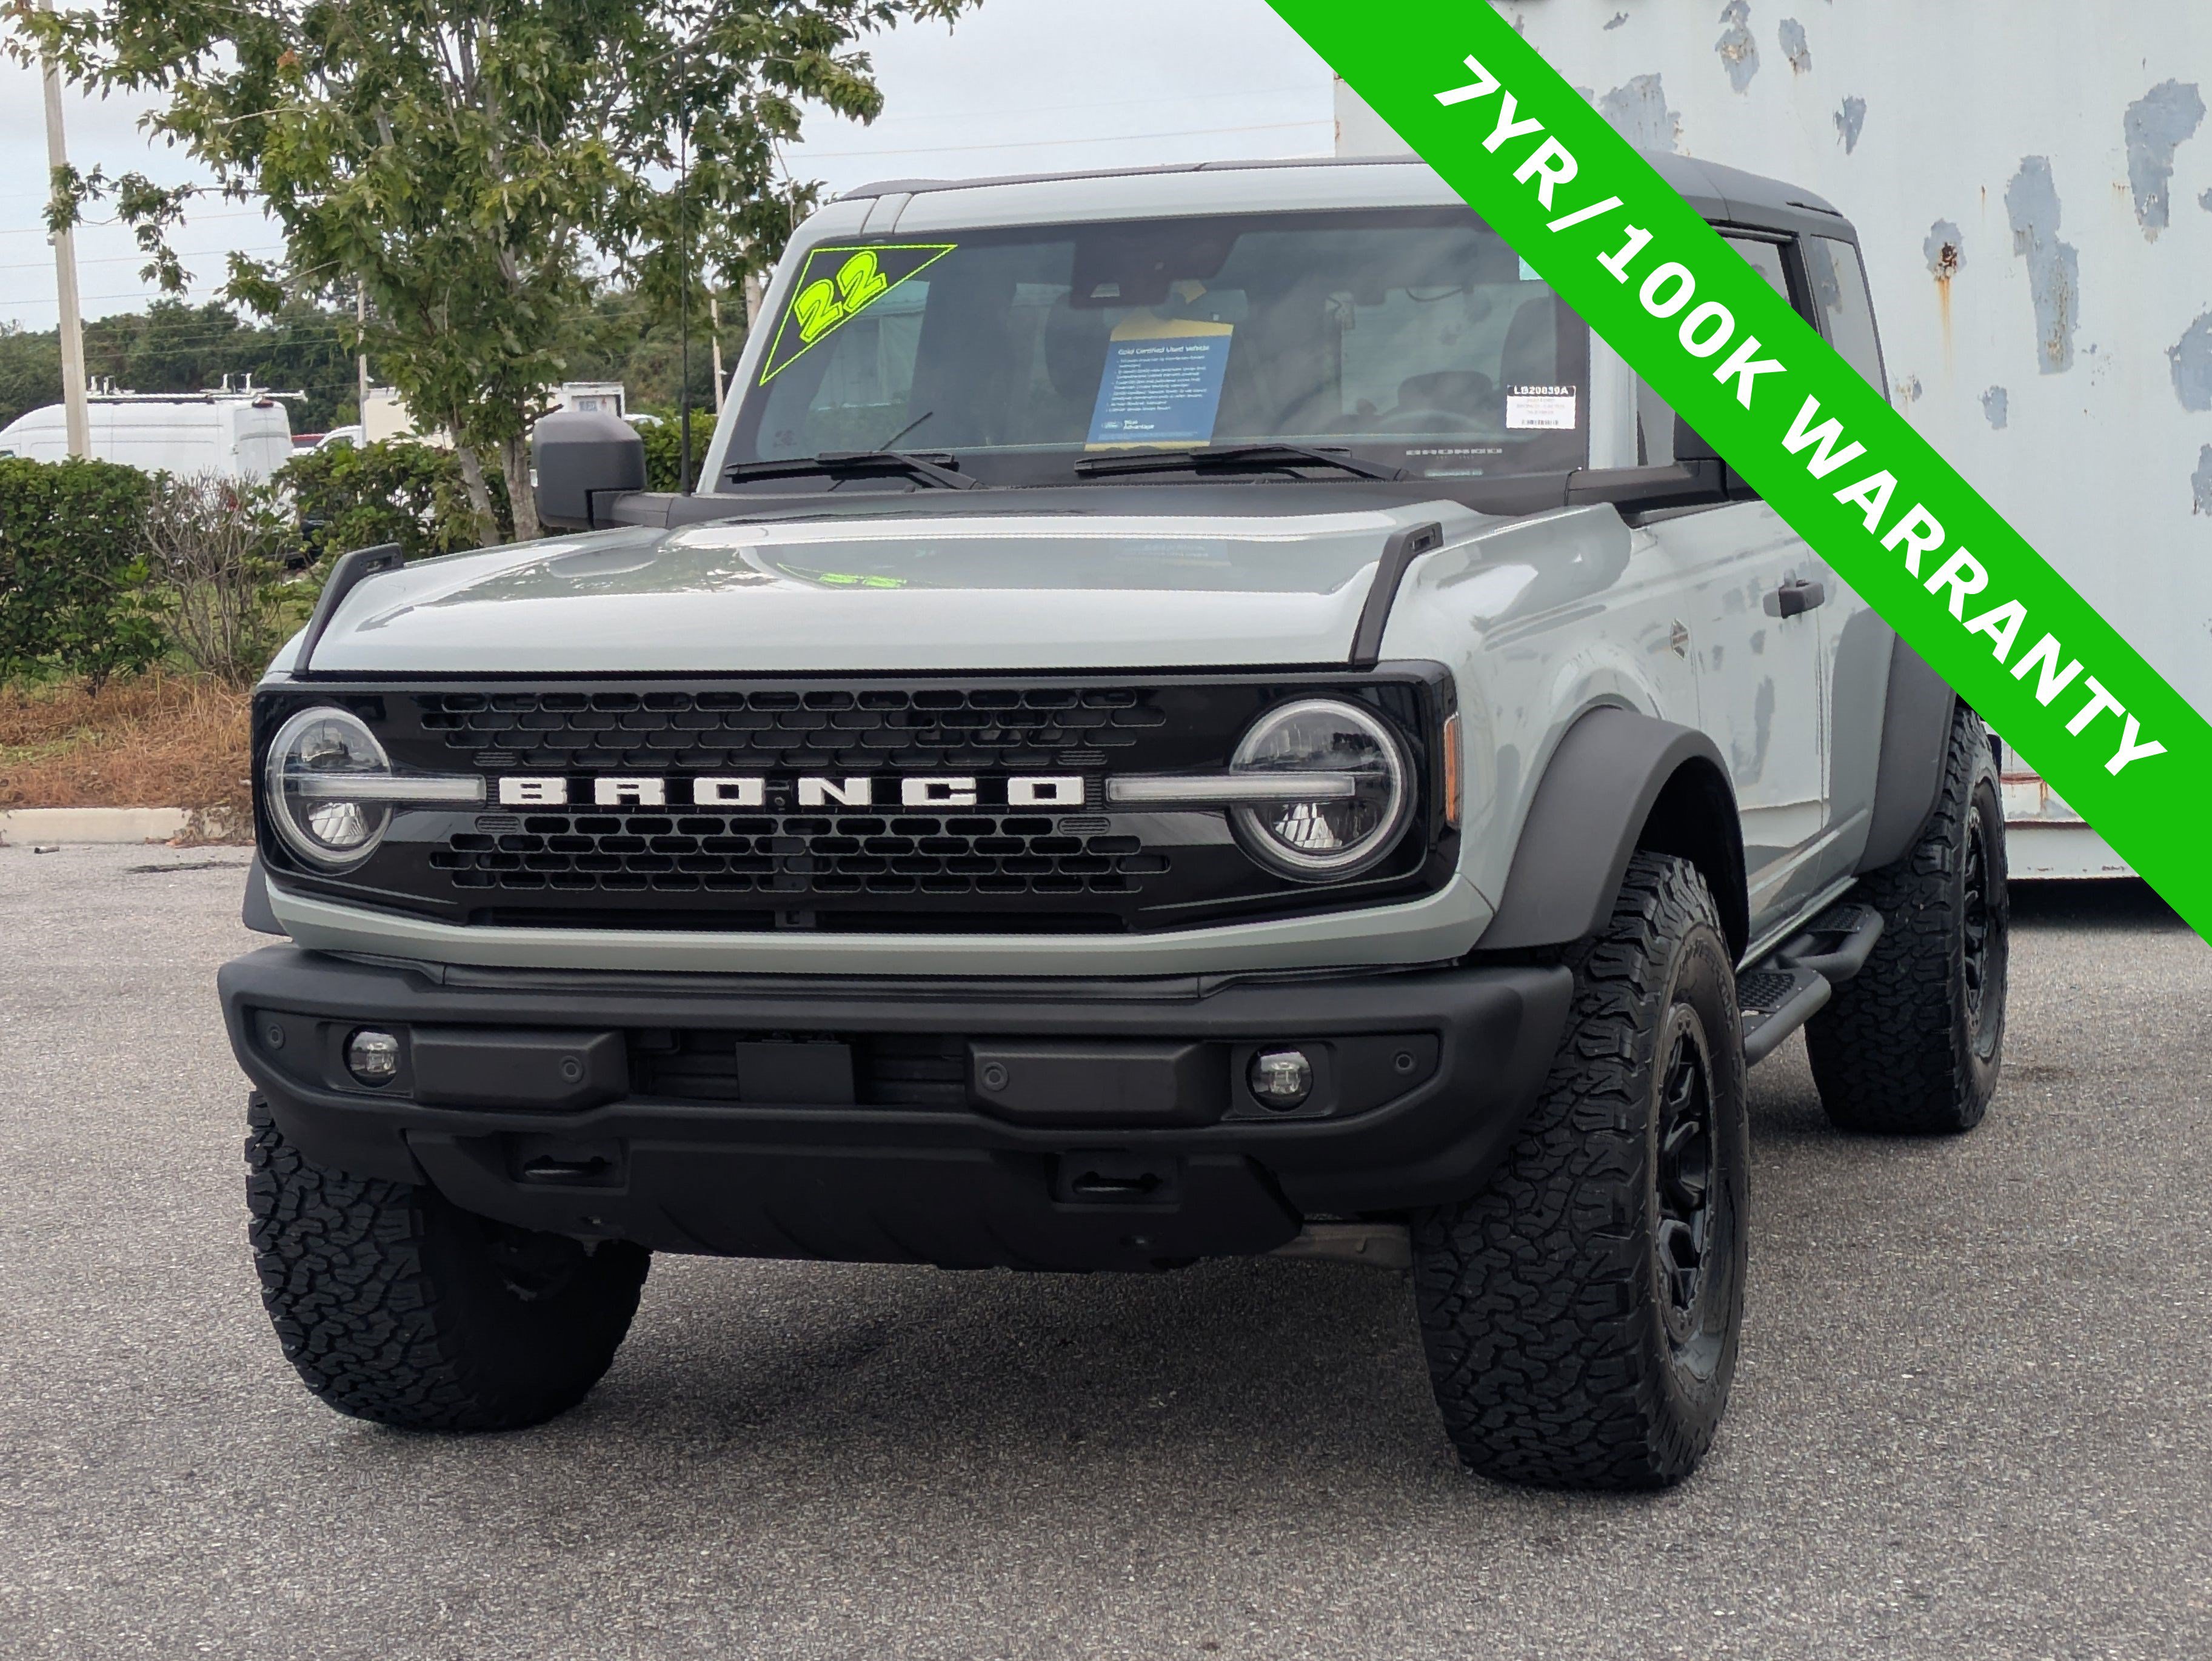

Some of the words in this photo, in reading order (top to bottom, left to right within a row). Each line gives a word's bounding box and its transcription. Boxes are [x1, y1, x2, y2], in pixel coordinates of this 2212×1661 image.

[794, 250, 887, 343] 22
[1135, 346, 1165, 355] Certified
[498, 777, 1084, 806] BRONCO
